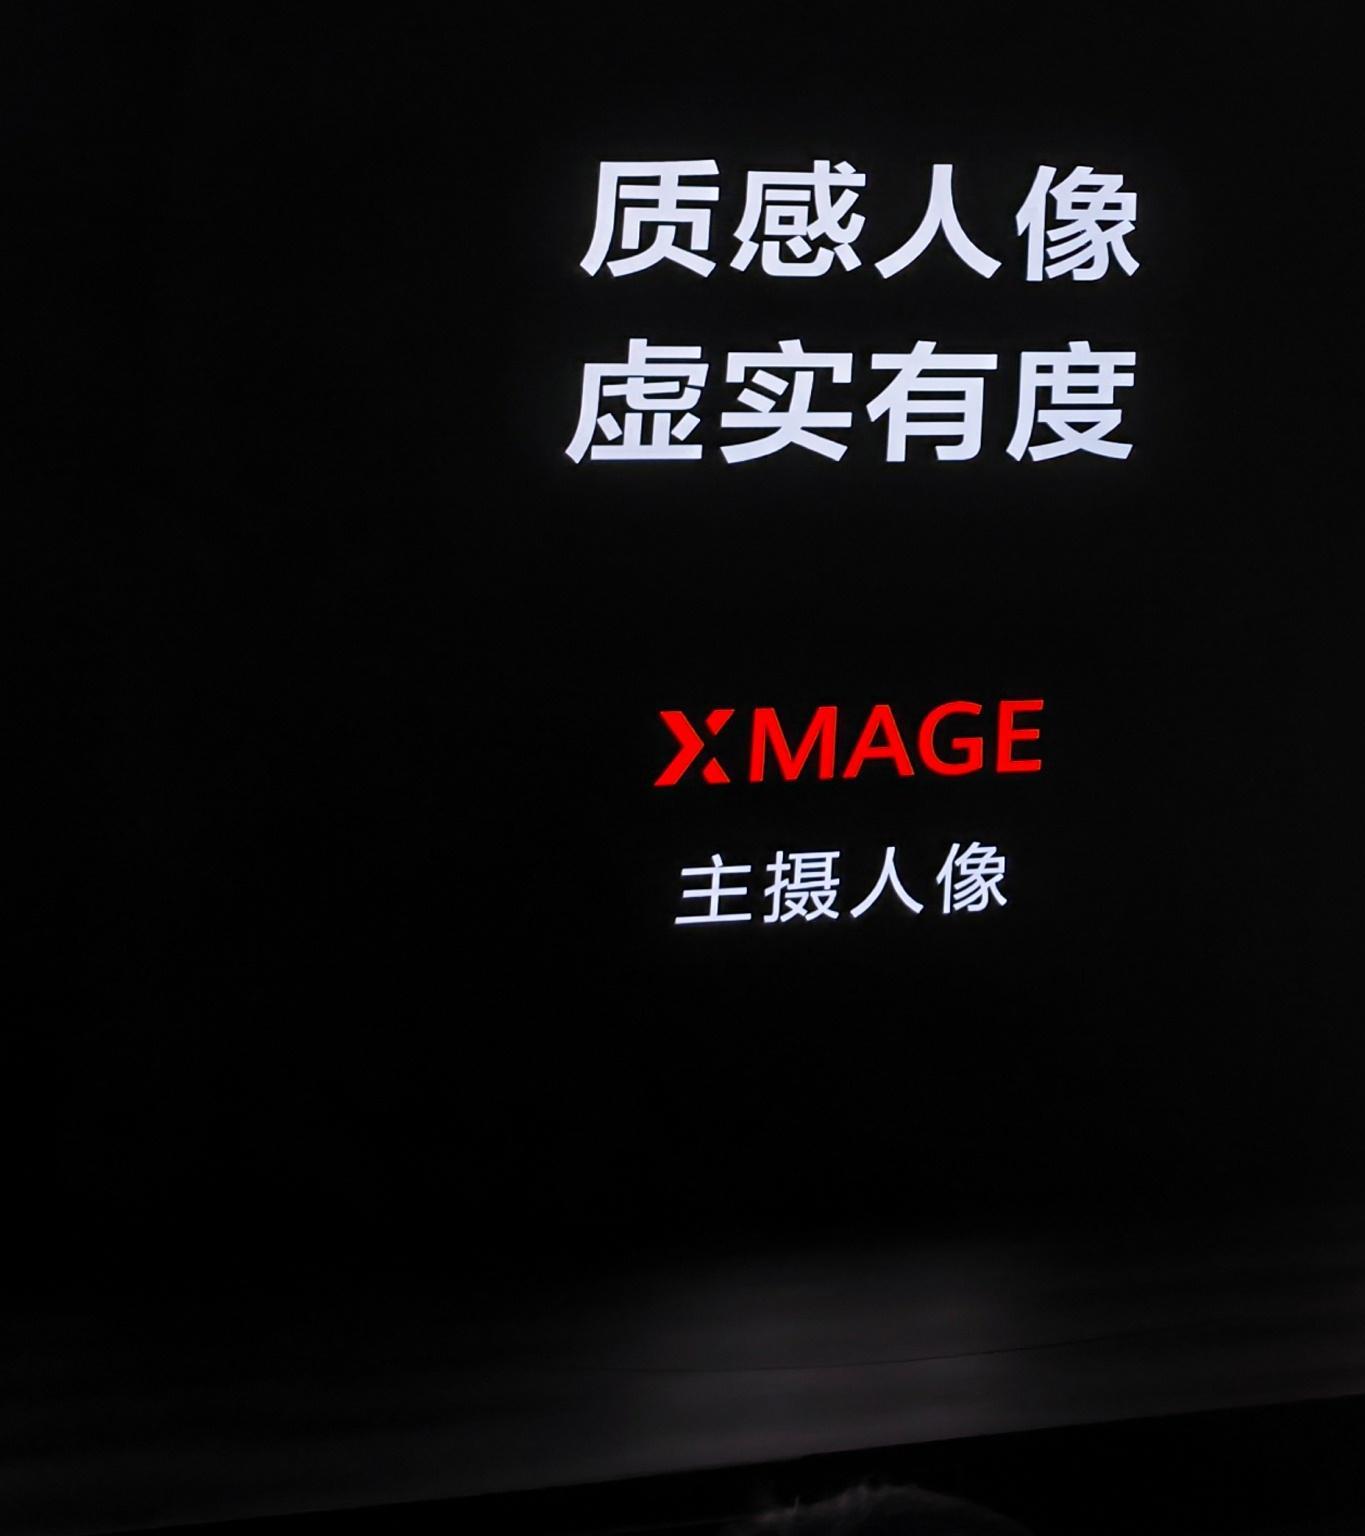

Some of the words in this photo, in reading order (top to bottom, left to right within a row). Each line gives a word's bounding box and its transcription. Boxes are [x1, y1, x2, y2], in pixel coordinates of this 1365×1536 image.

[579, 159, 1140, 282] 质感人像
[564, 337, 1137, 465] 虚实有度
[654, 699, 1045, 787] XMAGE
[674, 841, 1008, 925] 主摄人像
